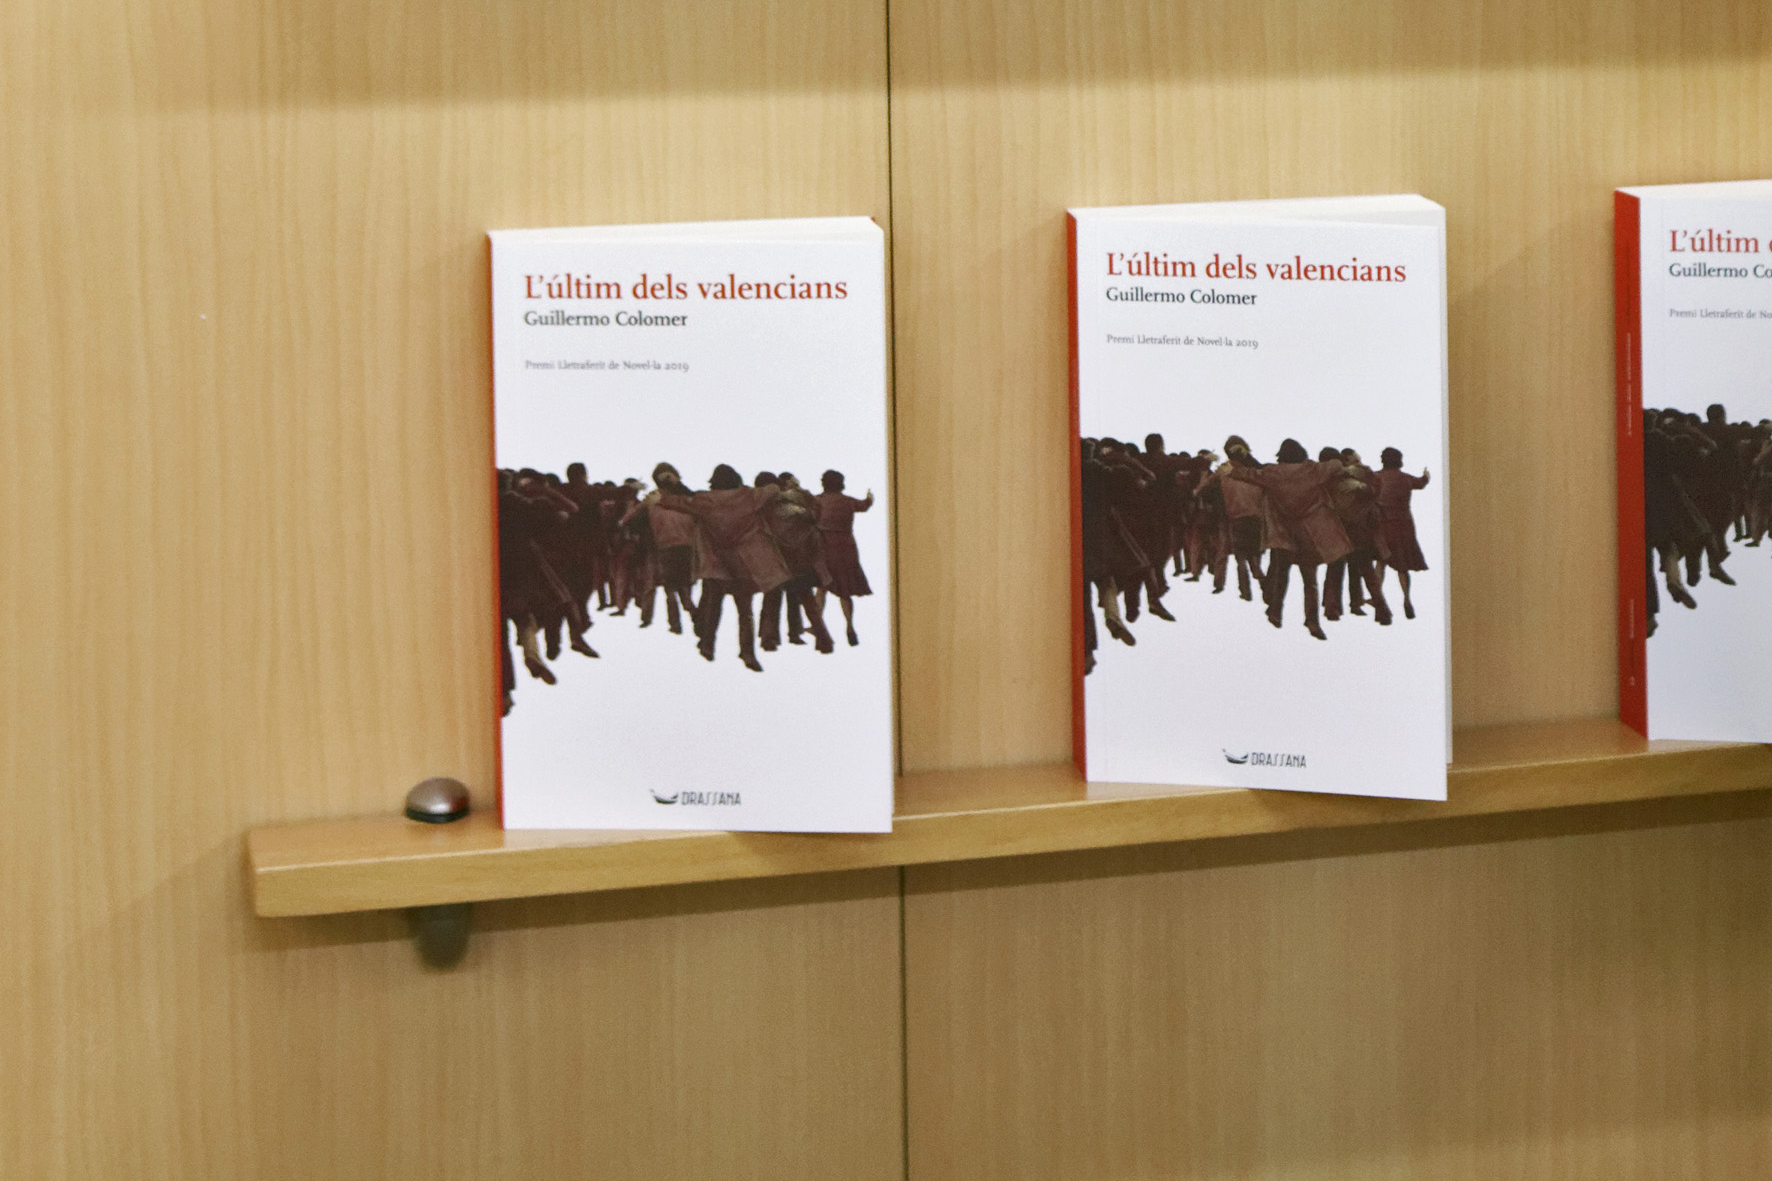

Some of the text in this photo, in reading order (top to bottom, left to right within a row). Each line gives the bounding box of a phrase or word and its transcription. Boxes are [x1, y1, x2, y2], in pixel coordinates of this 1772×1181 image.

[1670, 228, 1760, 254] L'últim
[1107, 251, 1407, 283] L'últim dels valencians
[1668, 262, 1749, 278] Guillermo
[525, 272, 848, 300] L'últim dels valencians
[1105, 286, 1258, 306] Guillermo Colomer
[523, 309, 688, 327] Guillermo Colomer
[1669, 308, 1697, 318] Premi
[1745, 308, 1757, 320] de
[1106, 333, 1135, 344] Premi
[1137, 333, 1182, 346] Lletraferit
[1182, 335, 1195, 346] de
[1235, 339, 1259, 351] 2019
